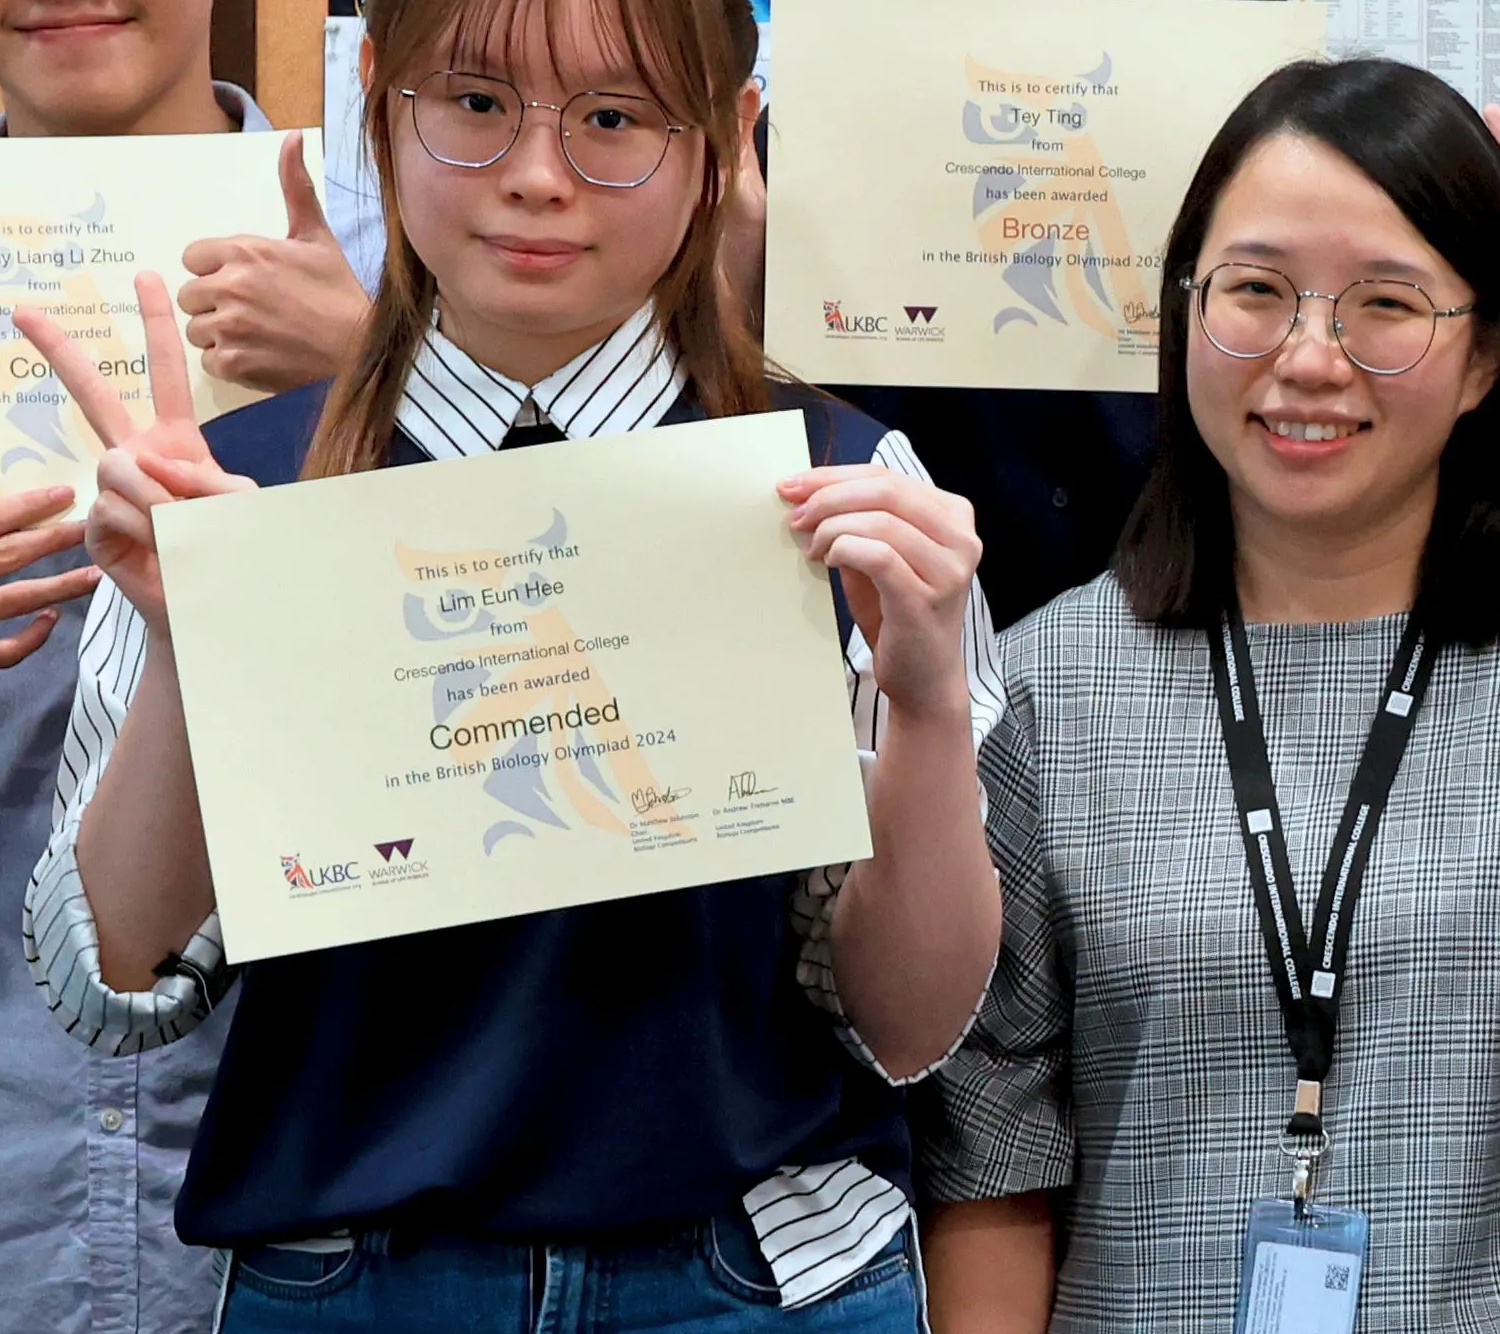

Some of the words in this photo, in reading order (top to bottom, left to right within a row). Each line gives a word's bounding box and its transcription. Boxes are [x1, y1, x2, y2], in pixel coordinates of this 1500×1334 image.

[1010, 107, 1041, 128] Tey
[1045, 108, 1082, 130] Ting
[1002, 217, 1090, 245] Bronze
[16, 250, 64, 268] Liang
[69, 249, 85, 264] Li
[90, 248, 135, 264] Zhuo
[439, 594, 476, 613] Lim
[480, 587, 520, 607] Eun
[524, 580, 565, 600] Hee
[429, 696, 620, 751] Commended
[385, 776, 400, 788] in
[404, 770, 431, 785] the
[435, 760, 487, 780] British
[491, 752, 550, 771] Biology
[554, 735, 630, 761] Olympiad
[635, 729, 676, 748] 2024
[367, 860, 429, 880] WARWICK
[1322, 912, 1339, 969] CRESCENDO
[1331, 841, 1358, 913] INTERNATIONAL
[1351, 803, 1371, 842] COLLEGE
[1257, 833, 1275, 884] CRESCENDO
[1267, 883, 1292, 959] INTERNATIONAL
[1284, 957, 1302, 1000] COLLEGE
